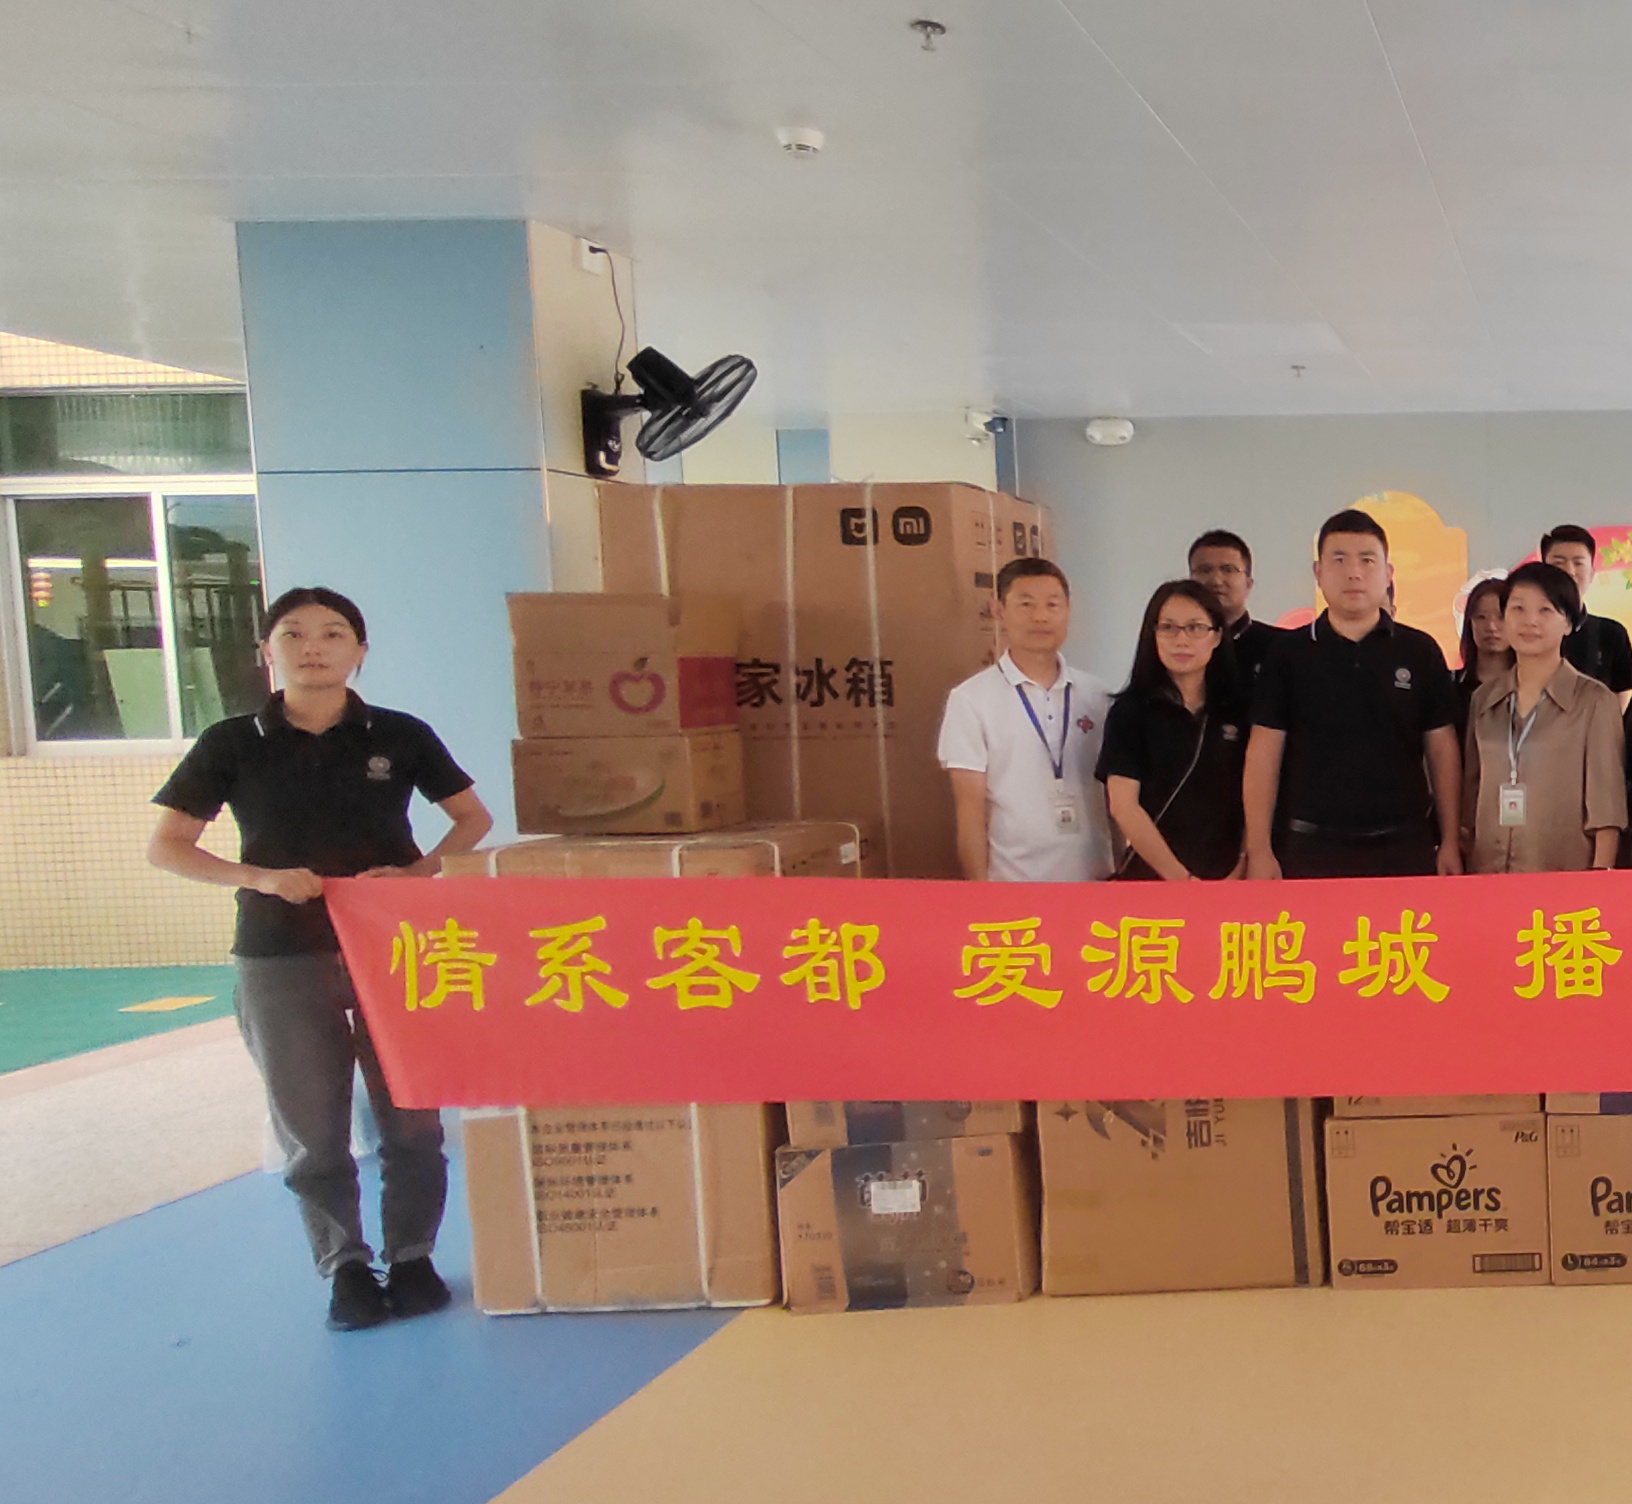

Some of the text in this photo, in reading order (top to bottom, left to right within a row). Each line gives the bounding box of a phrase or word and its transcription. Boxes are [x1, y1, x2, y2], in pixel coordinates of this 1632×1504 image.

[391, 916, 886, 1011] 情系客都
[954, 910, 1450, 1008] 爱源鹏城
[1370, 1175, 1502, 1219] Pampers
[1384, 1219, 1434, 1235] 帮宝适
